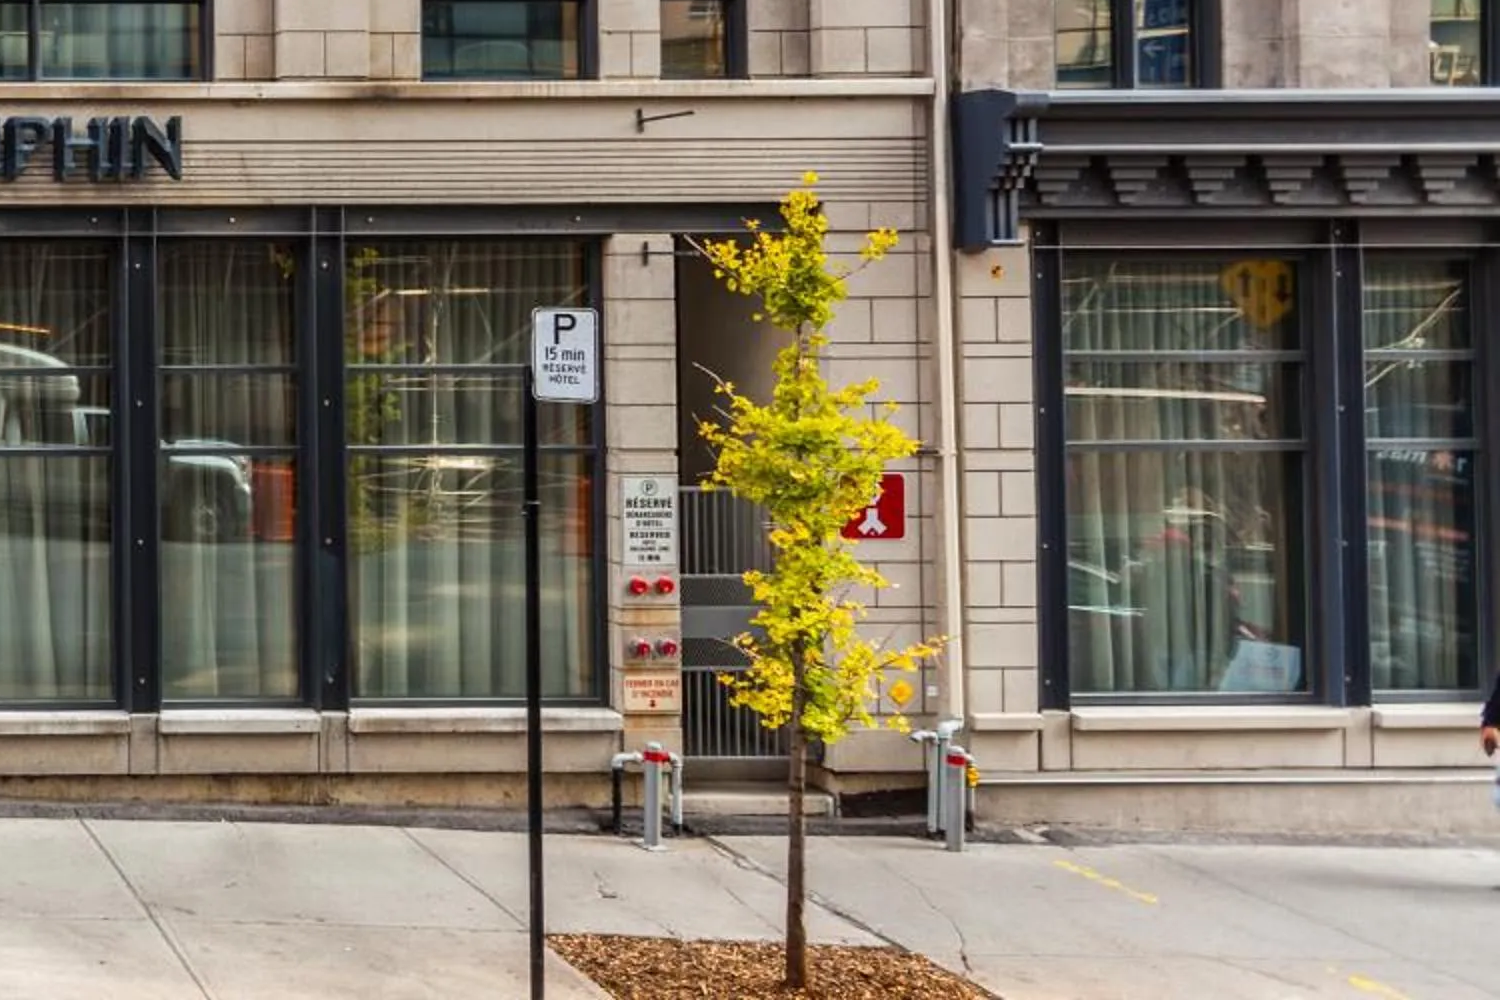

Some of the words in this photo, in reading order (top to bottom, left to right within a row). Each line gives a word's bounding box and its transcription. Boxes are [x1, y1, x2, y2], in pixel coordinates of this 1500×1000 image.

[554, 313, 577, 345] P
[545, 346, 557, 361] 15
[561, 347, 585, 361] min
[625, 495, 672, 508] RÉSERVÉ
